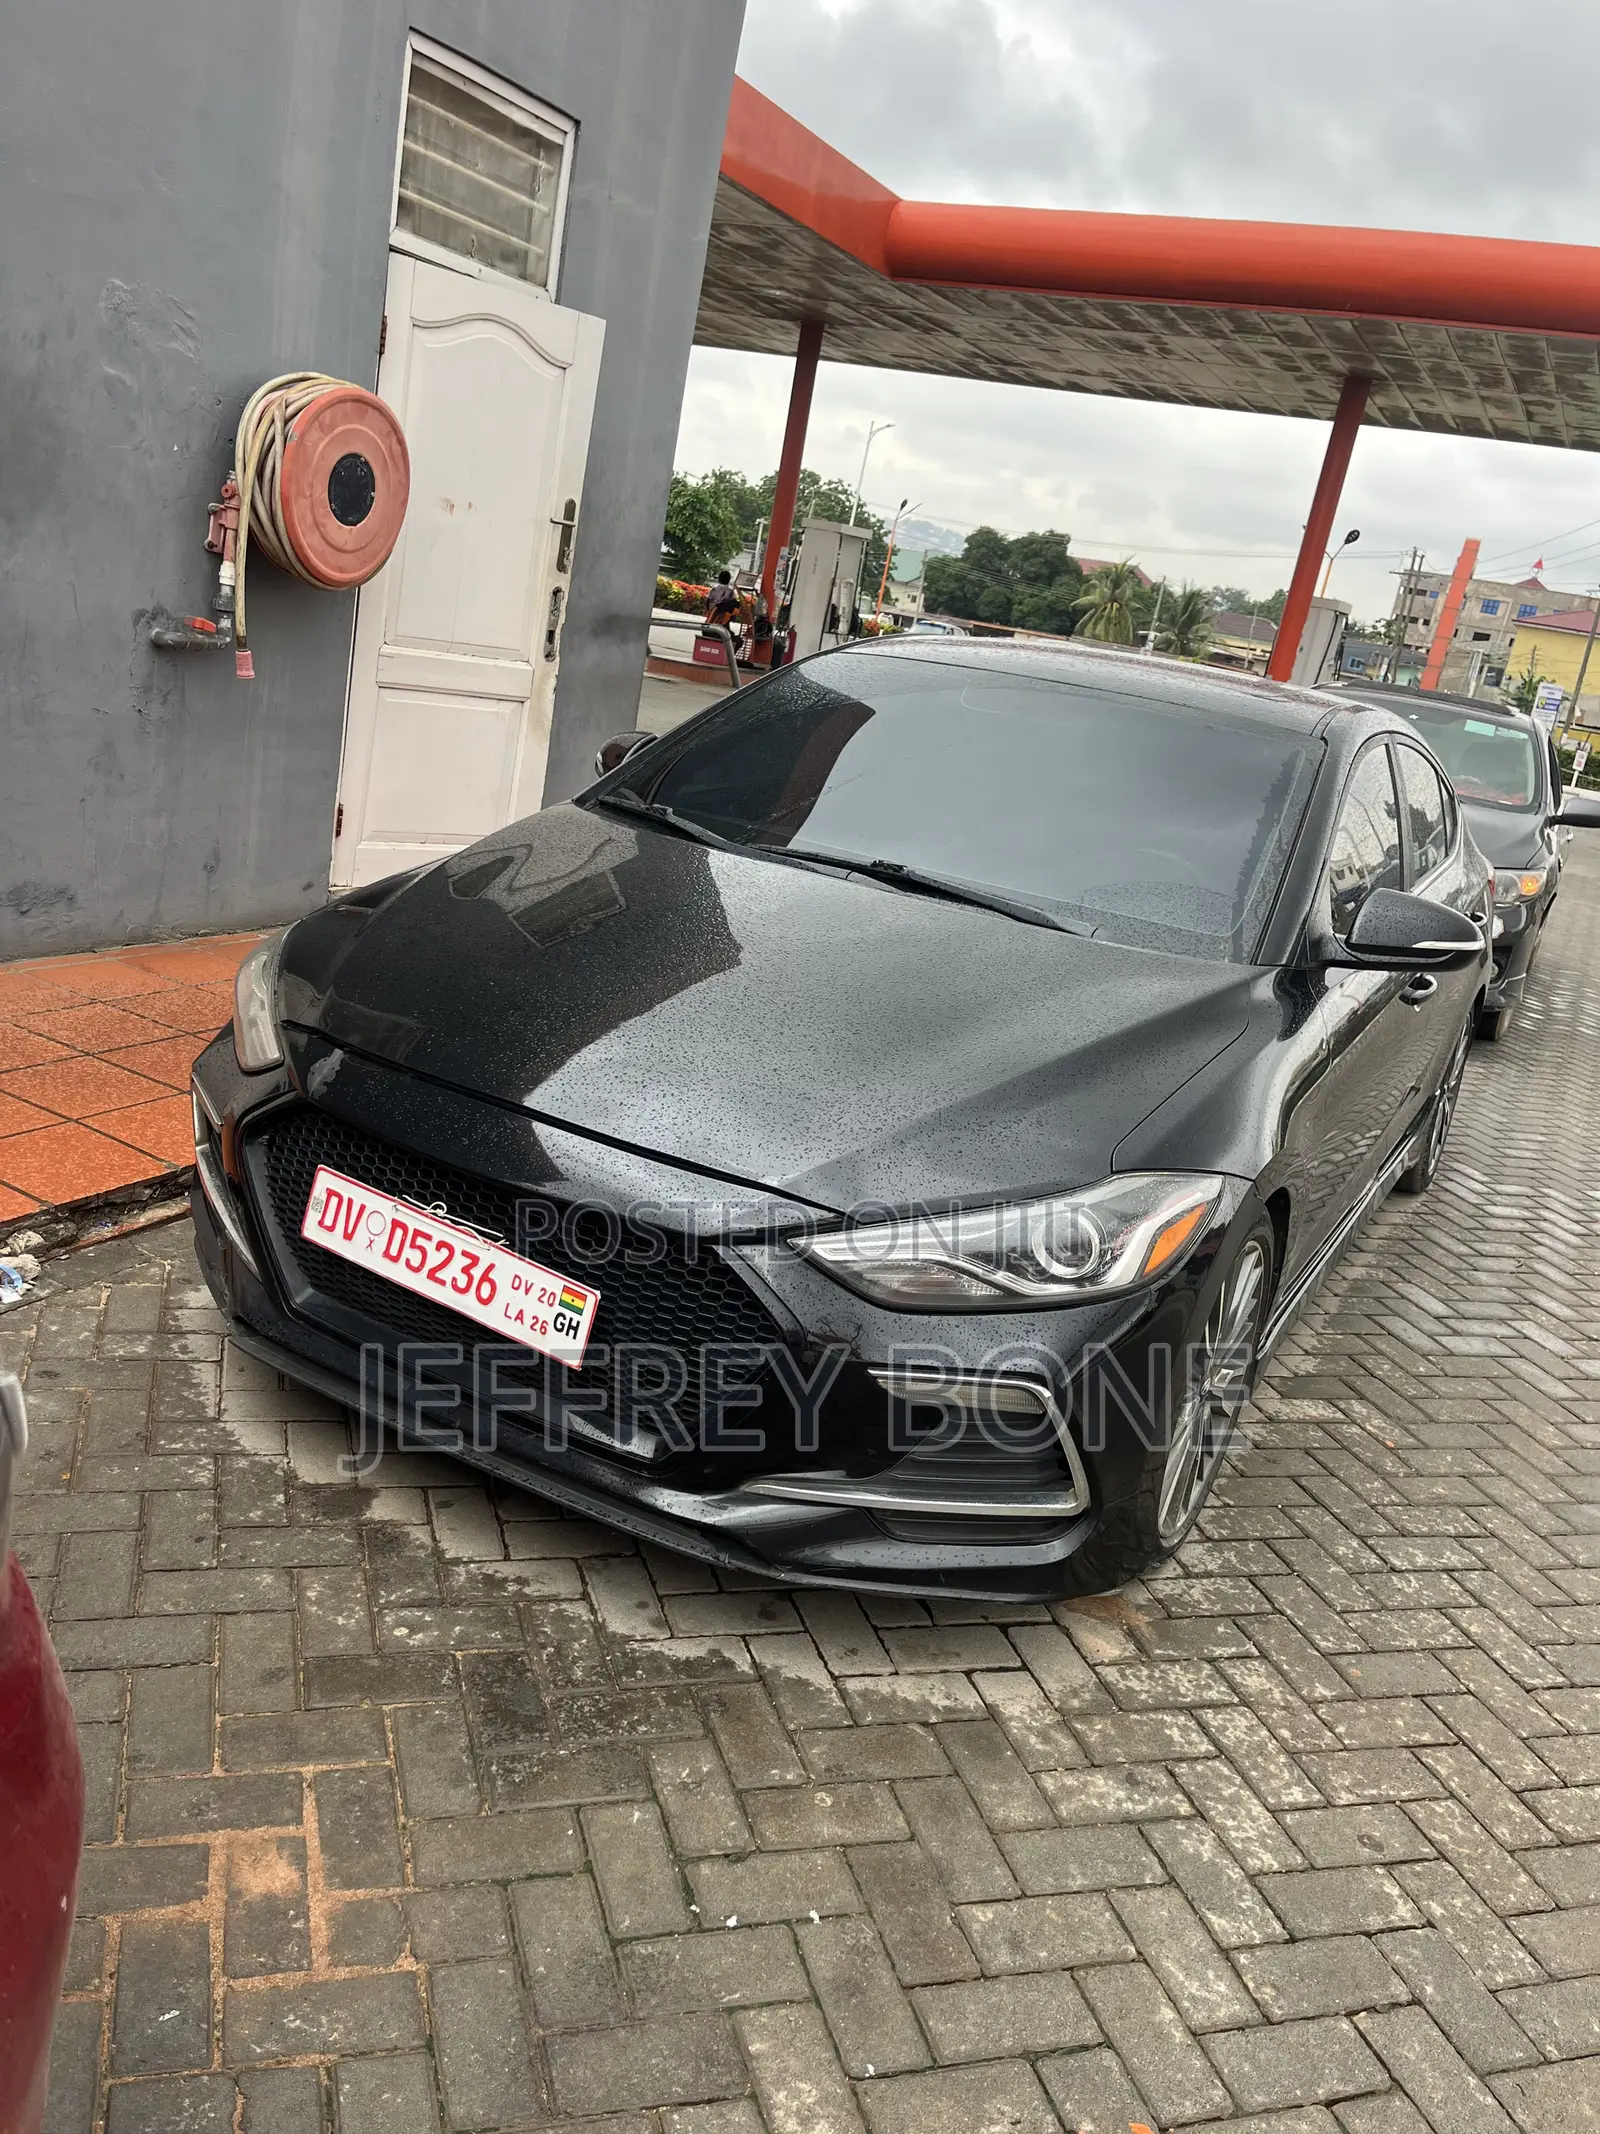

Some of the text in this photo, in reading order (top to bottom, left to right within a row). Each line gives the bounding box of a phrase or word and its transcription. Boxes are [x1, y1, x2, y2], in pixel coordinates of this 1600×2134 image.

[317, 1187, 498, 1306] DV D5236
[511, 1274, 556, 1308] DV 20
[503, 1303, 548, 1336] LA 26
[553, 1312, 581, 1340] GH
